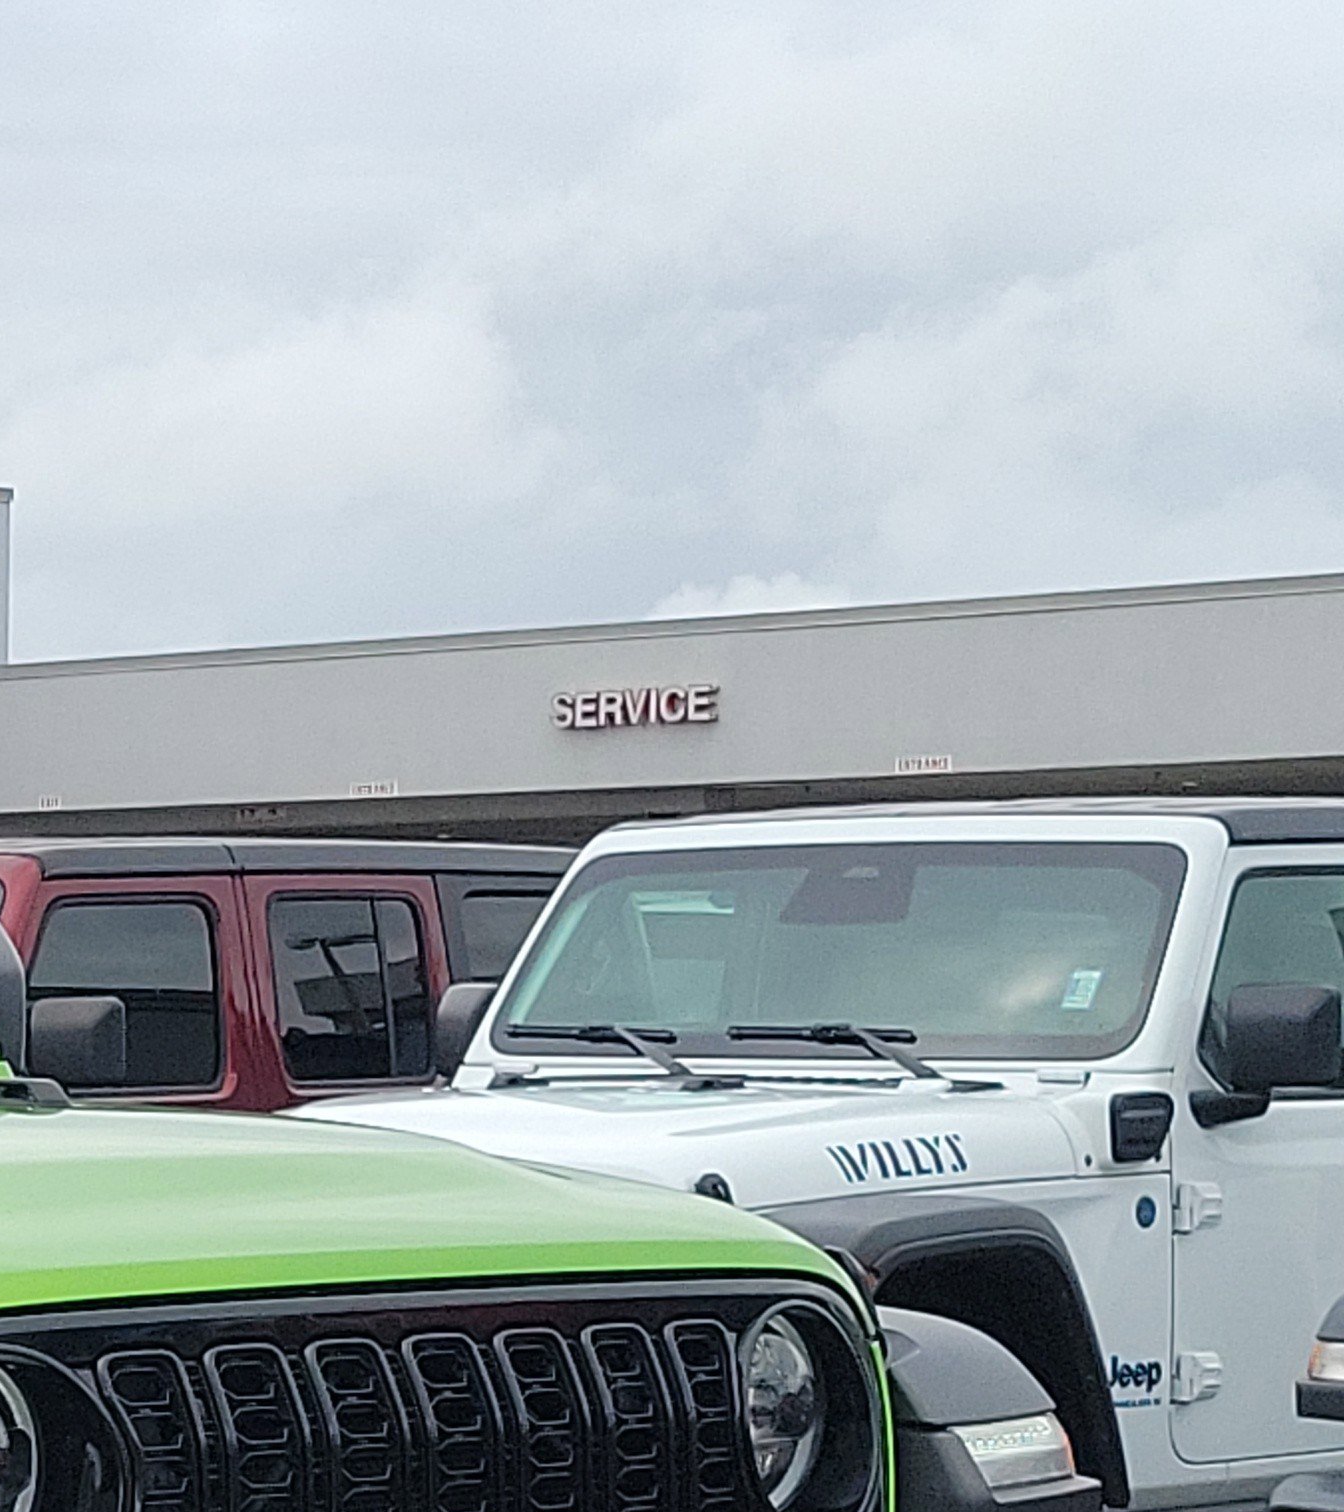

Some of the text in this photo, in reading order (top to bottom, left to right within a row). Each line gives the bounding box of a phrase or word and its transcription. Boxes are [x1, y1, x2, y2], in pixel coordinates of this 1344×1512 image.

[551, 683, 720, 730] SERVICE
[825, 1133, 968, 1183] WILLYS
[1109, 1354, 1162, 1394] Jeep
